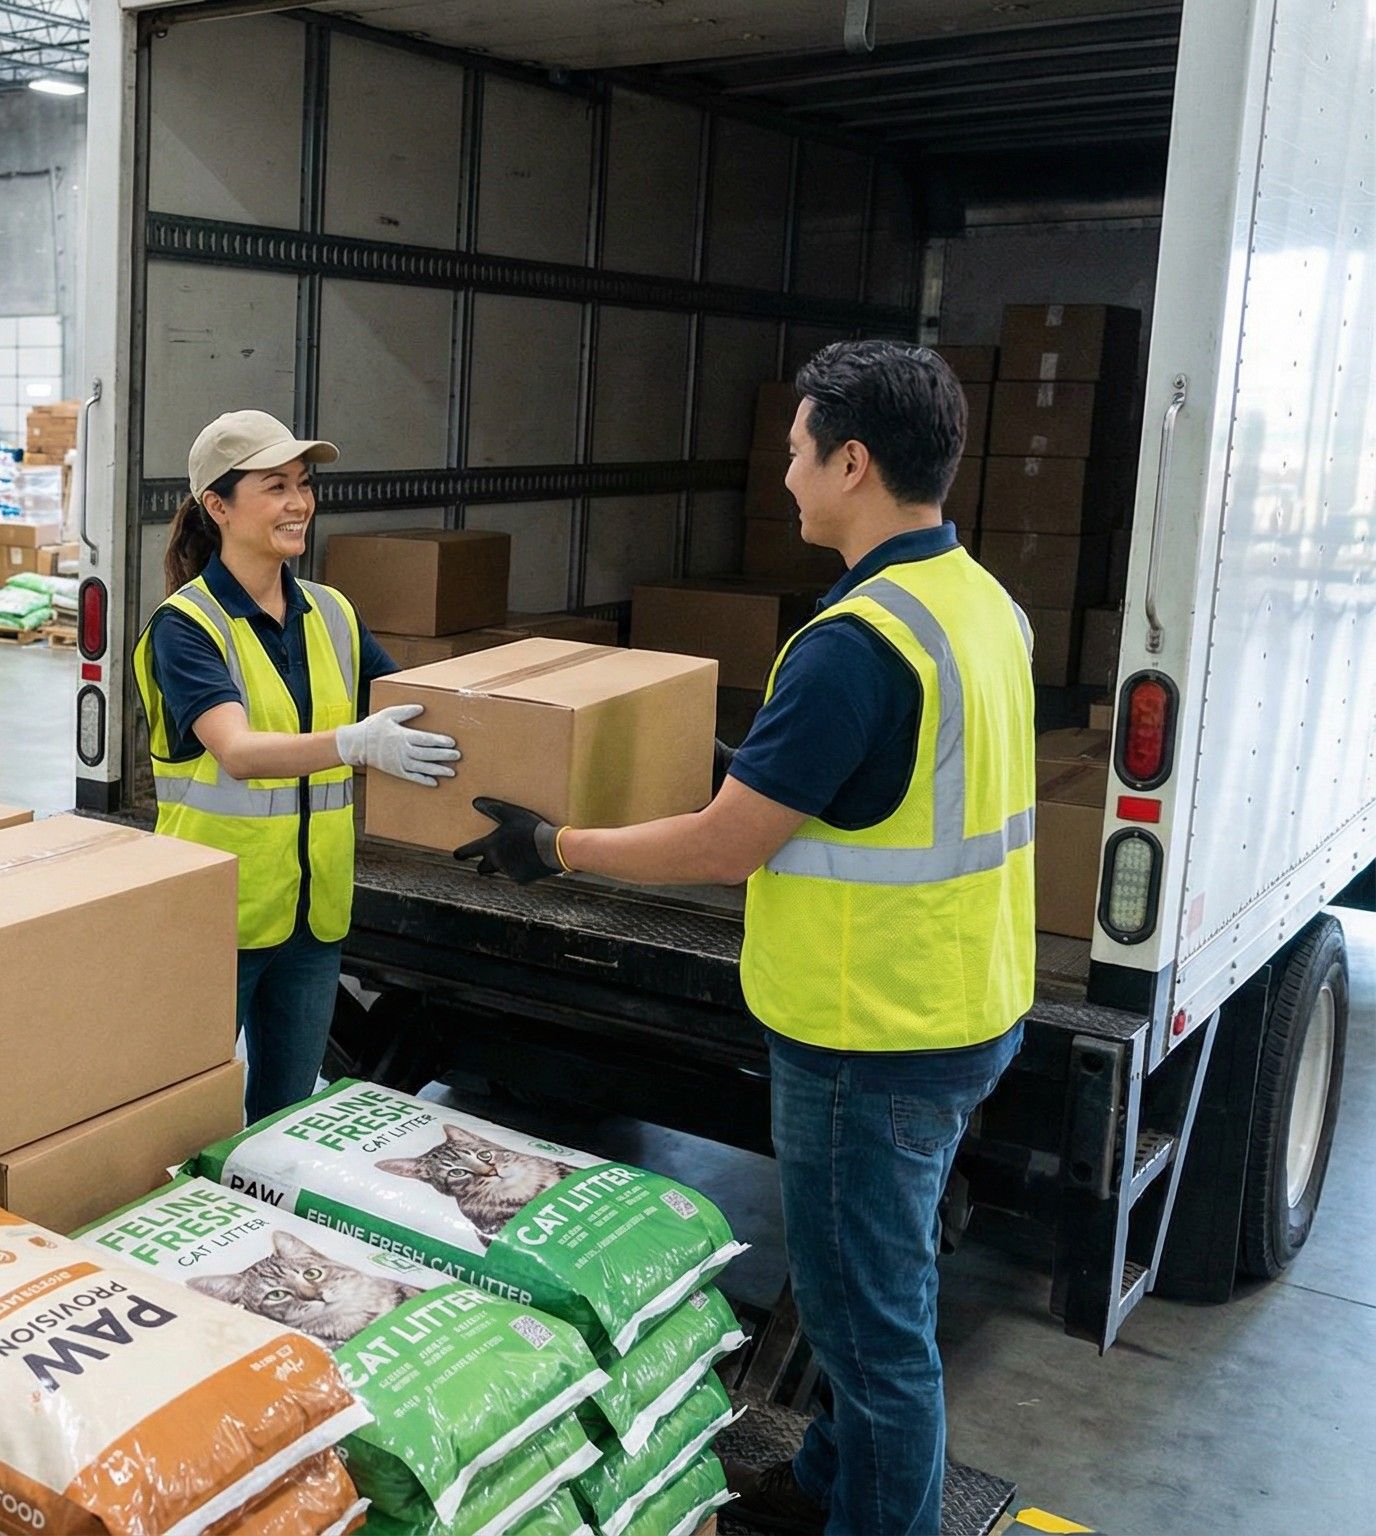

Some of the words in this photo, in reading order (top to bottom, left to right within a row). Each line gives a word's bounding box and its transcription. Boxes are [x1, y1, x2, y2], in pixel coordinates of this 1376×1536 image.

[282, 1090, 393, 1141] FELINE
[315, 1101, 424, 1151] FRESH
[362, 1133, 391, 1153] CAT
[388, 1114, 437, 1138] LITTER
[230, 1174, 284, 1207] PAW
[516, 1203, 569, 1246] CAT
[557, 1167, 641, 1213] LITTER
[96, 1189, 227, 1252] FELINE
[130, 1201, 257, 1266] FRESH
[178, 1245, 212, 1267] CAT
[211, 1218, 270, 1248] LITTER
[430, 1257, 465, 1281] CAT
[22, 1294, 178, 1393] PAW
[339, 1336, 400, 1389] CAT
[390, 1289, 494, 1345] LITTER
